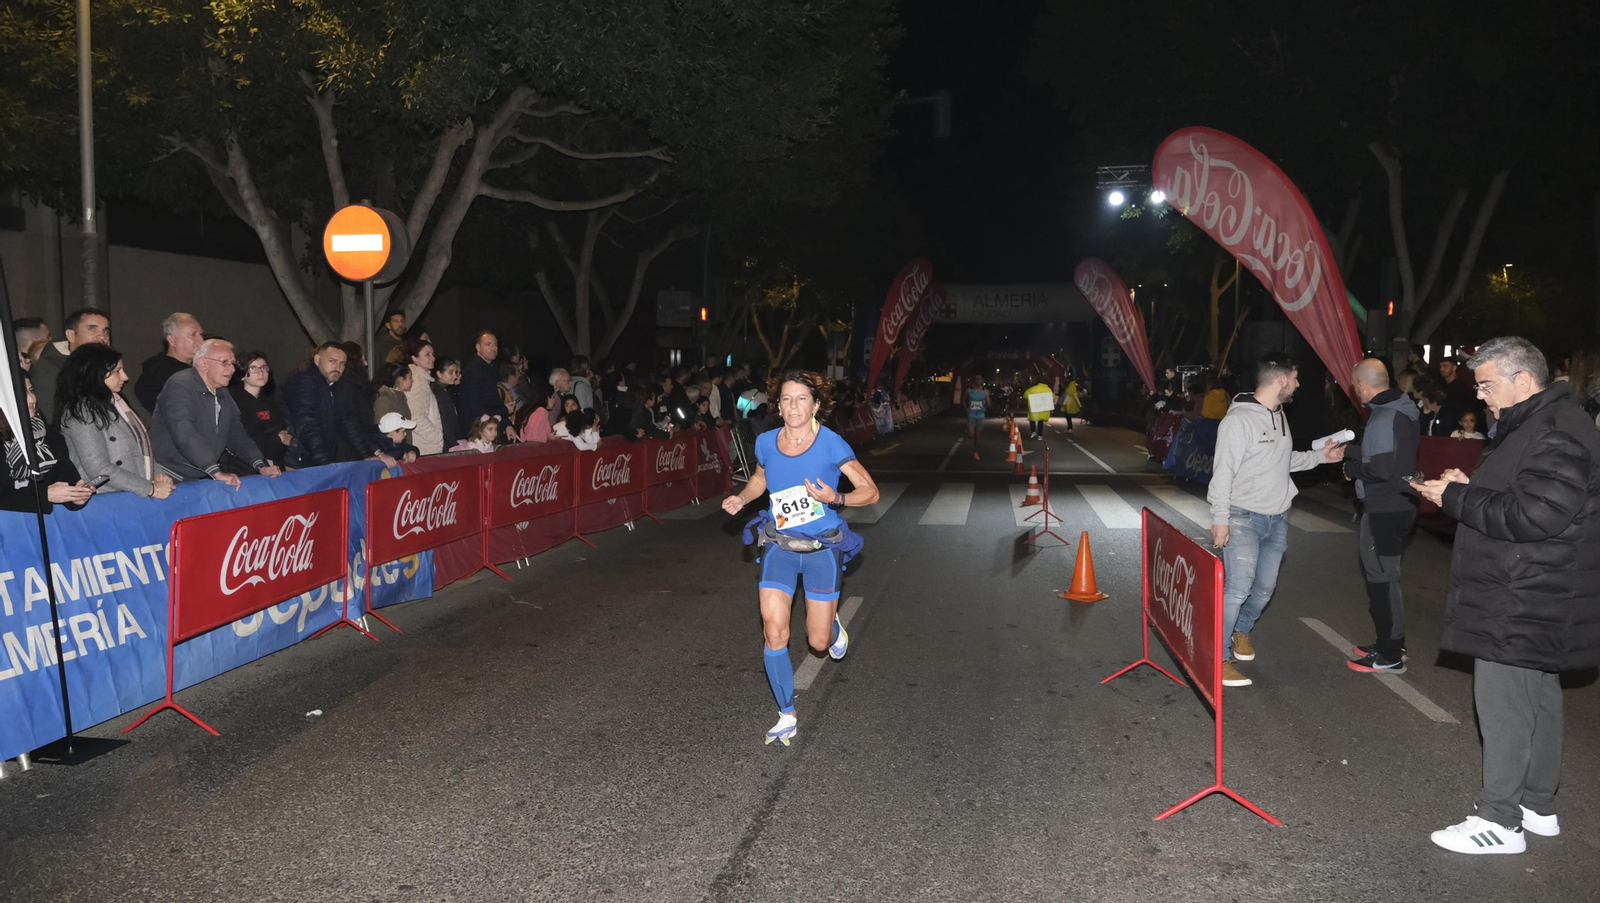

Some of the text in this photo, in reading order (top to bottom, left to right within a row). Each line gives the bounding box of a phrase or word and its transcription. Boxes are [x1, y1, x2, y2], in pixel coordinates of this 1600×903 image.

[973, 291, 1048, 308] ALMERÍA
[972, 310, 1011, 318] CIUDAD
[1186, 448, 1213, 477] depo
[782, 497, 809, 514] 618
[220, 511, 320, 596] Coca-Cola
[0, 543, 170, 616] TAMIENT
